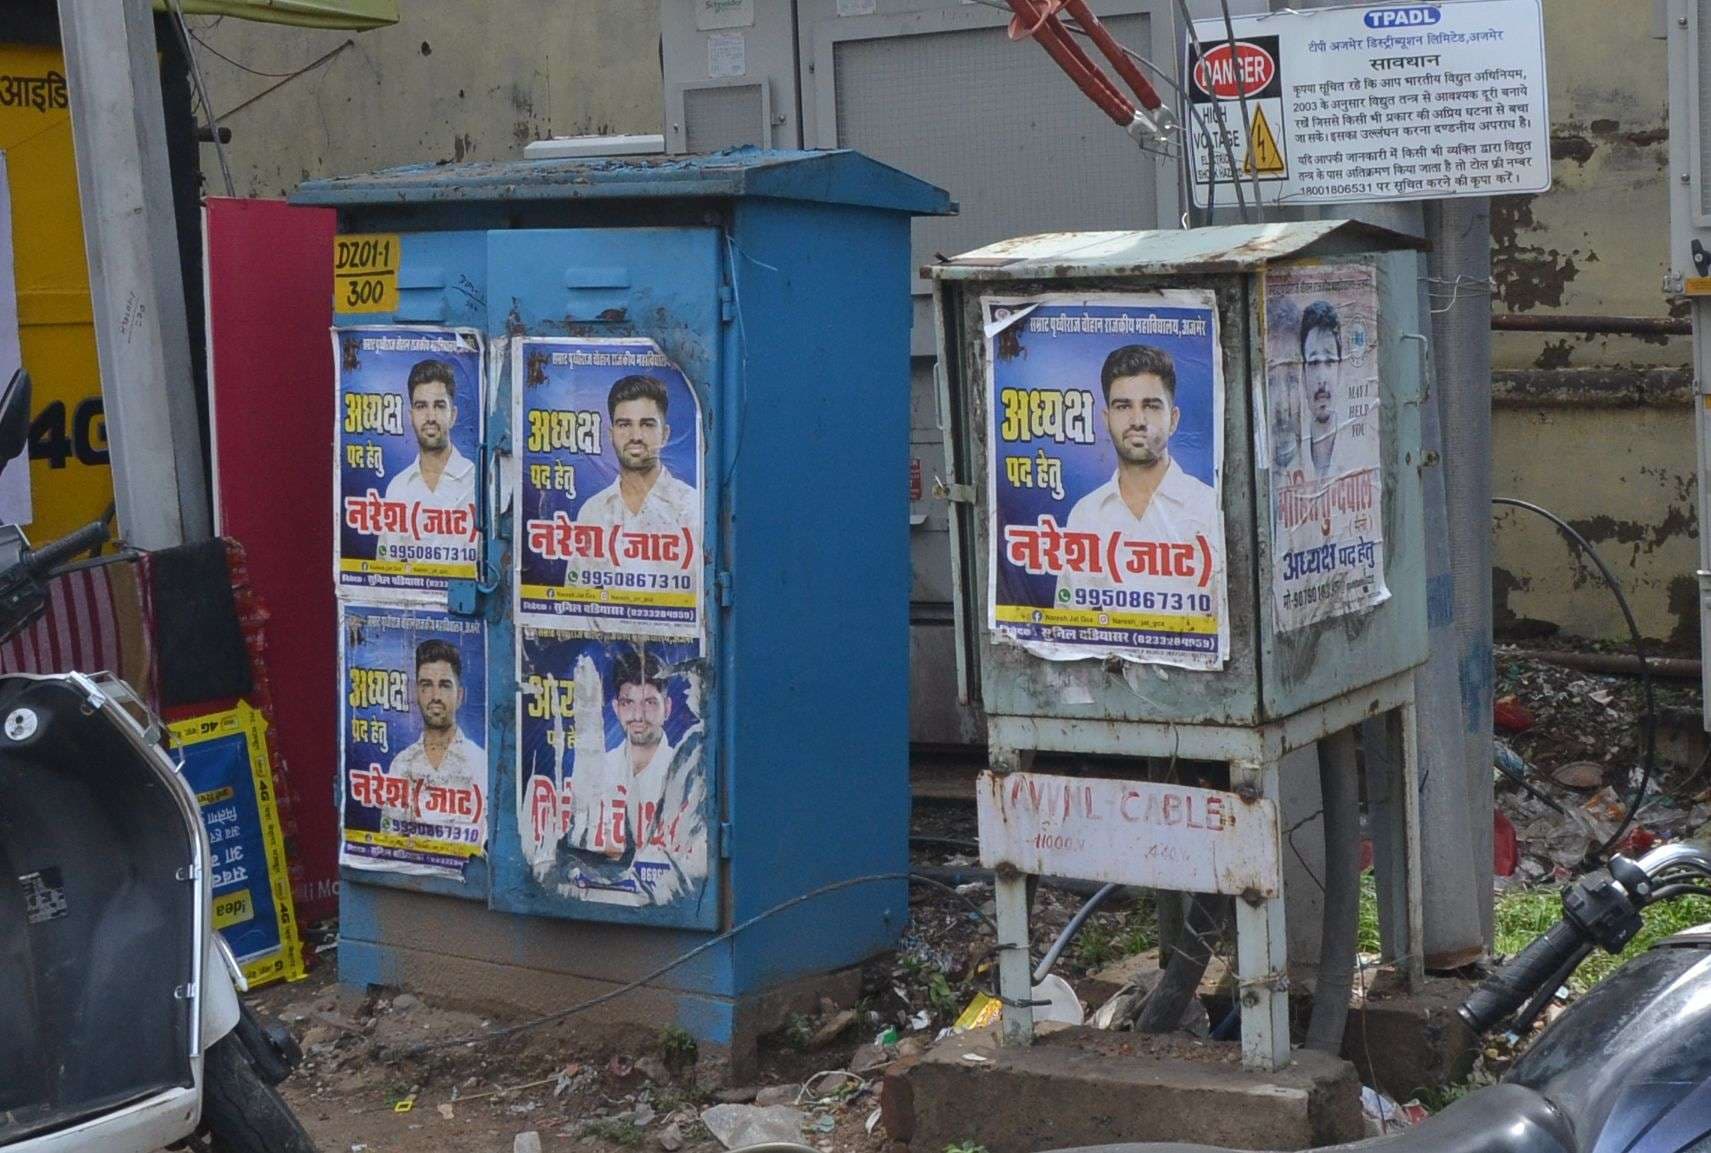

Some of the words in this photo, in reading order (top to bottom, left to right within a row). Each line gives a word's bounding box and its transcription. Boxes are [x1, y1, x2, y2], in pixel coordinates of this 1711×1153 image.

[1369, 9, 1435, 26] TPADL
[1308, 40, 1326, 52] टीपी
[1330, 37, 1364, 51] अजमेर
[1364, 77, 1377, 89] कि
[1381, 77, 1401, 88] आप
[1404, 72, 1441, 87] भारतीय
[1445, 71, 1471, 86] विद्युत
[1293, 101, 1317, 112] 2003
[1320, 98, 1329, 110] के
[1330, 98, 1366, 112] अनुसार
[1369, 95, 1395, 110] विद्युत
[1422, 90, 1431, 103] से
[1435, 90, 1479, 102] आवश्यक
[1482, 87, 1498, 101] दूरी
[1312, 114, 1339, 127] जिससे
[1342, 111, 1367, 125] किसी
[1370, 111, 1382, 123] भी
[1386, 112, 1413, 122] प्रकार
[1417, 107, 1430, 120] की
[1432, 106, 1462, 119] अप्रिय
[1465, 106, 1492, 116] घटना
[1496, 102, 1505, 114] से
[1508, 103, 1529, 113] बचा
[1194, 130, 1240, 150] VOTAGE
[1295, 134, 1306, 143] जा
[1403, 125, 1431, 137] करना
[1434, 120, 1475, 134] दण्डनीय
[1479, 119, 1516, 131] अपराध
[1298, 154, 1312, 166] यदि
[1314, 151, 1343, 164] आपकी
[1346, 148, 1387, 162] जानकारी
[1402, 145, 1427, 158] किसी
[1431, 144, 1443, 156] भी
[1504, 139, 1532, 154] विद्युत
[1316, 168, 1325, 180] के
[1327, 170, 1343, 180] पास
[1346, 166, 1390, 179] अतिक्रमण
[1393, 163, 1416, 175] किया
[1420, 163, 1441, 173] जाता
[1444, 159, 1452, 172] है
[1455, 159, 1466, 171] तो
[1470, 158, 1488, 170] टोल
[1377, 182, 1390, 192] पर
[1427, 175, 1451, 188] करने
[1455, 174, 1468, 187] की
[1470, 174, 1491, 188] कृपा
[347, 280, 384, 307] 300
[345, 393, 404, 435] अध्यक्ष
[1001, 388, 1095, 444] अध्यक्ष
[528, 410, 601, 456] अध्यक्ष
[347, 444, 365, 468] पद
[366, 440, 385, 478] हेतु
[531, 464, 551, 490] पद
[554, 459, 576, 499] हेतु
[1006, 455, 1033, 489] पद
[1036, 449, 1064, 500] हेतु
[389, 545, 476, 562] 9950867310
[1005, 514, 1101, 574] नरेश
[1283, 544, 1336, 581] अध्यक्ष
[1338, 545, 1355, 568] पद
[1357, 535, 1376, 569] हेतु
[581, 570, 691, 590] 9950867310
[1075, 587, 1212, 613] 9950867310
[350, 668, 409, 713] अध्यक्ष
[352, 718, 368, 744] पद
[369, 714, 388, 753] हेतु
